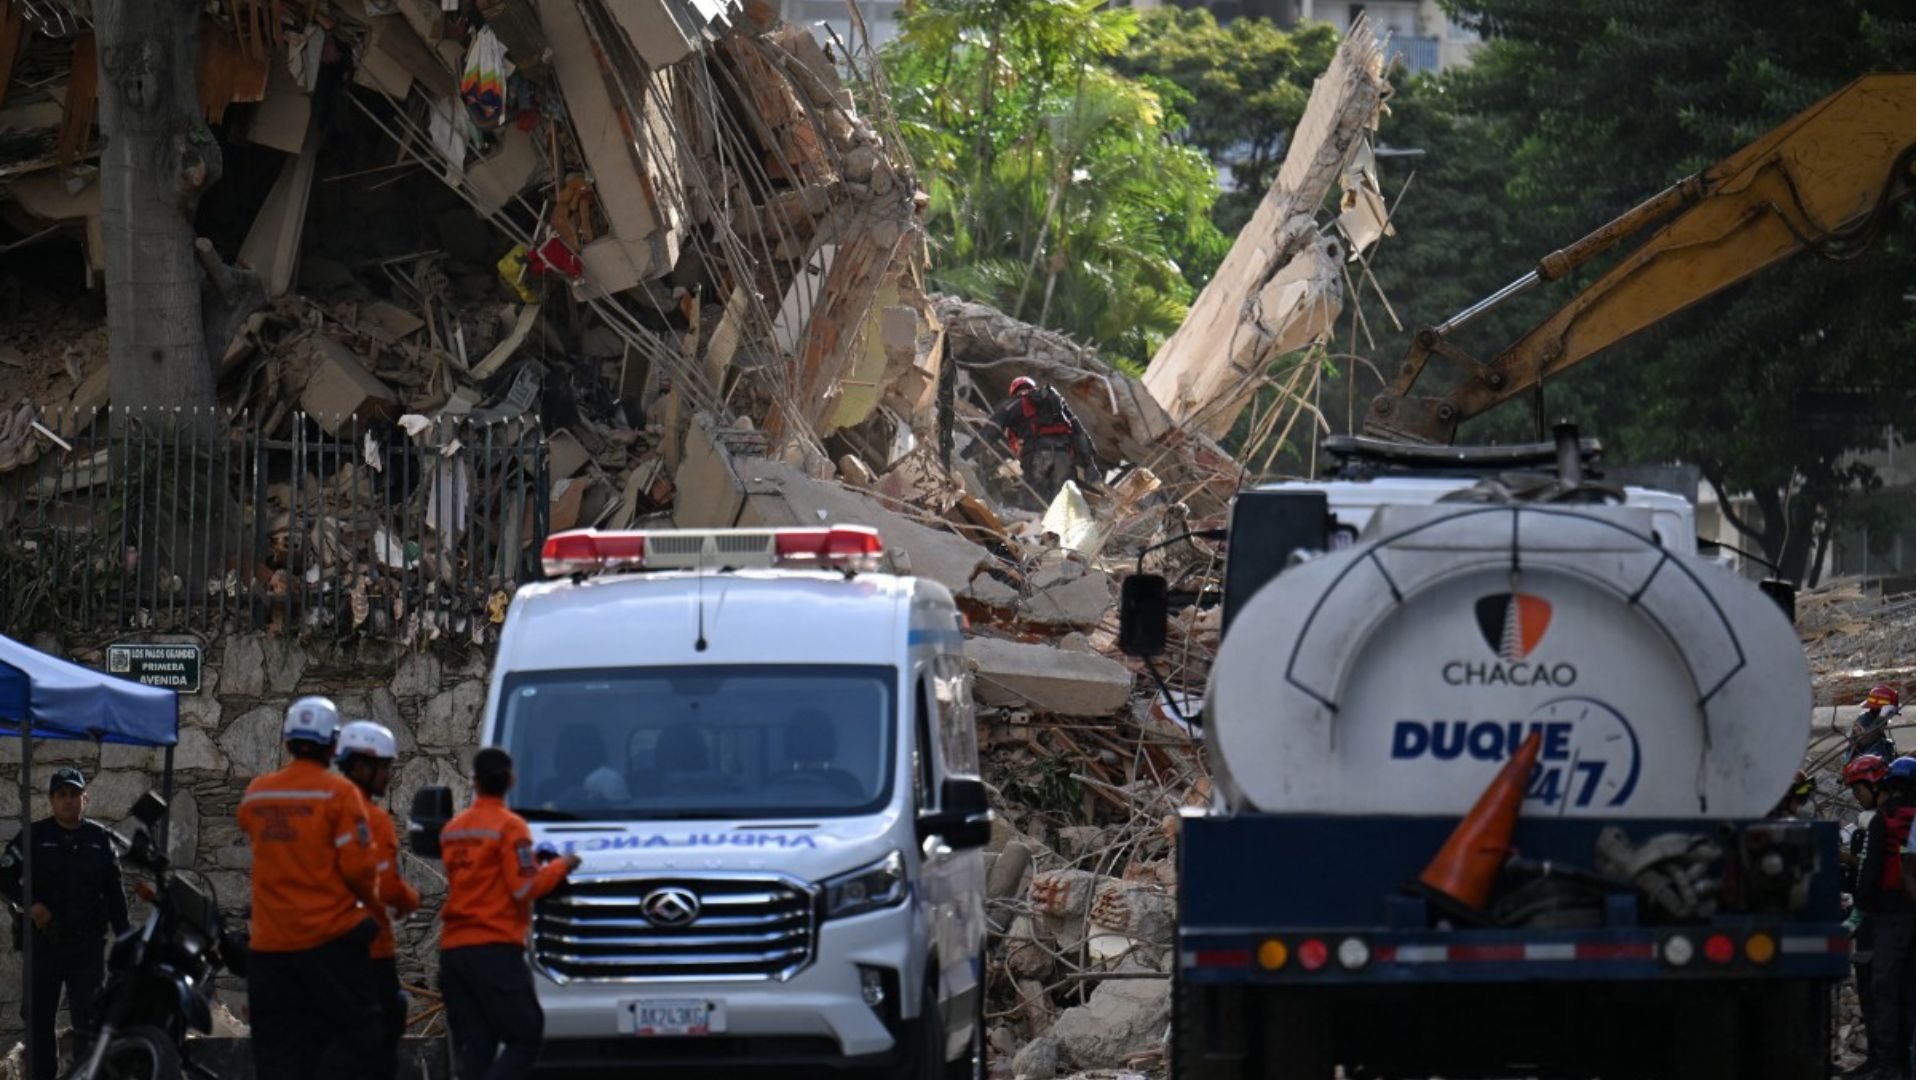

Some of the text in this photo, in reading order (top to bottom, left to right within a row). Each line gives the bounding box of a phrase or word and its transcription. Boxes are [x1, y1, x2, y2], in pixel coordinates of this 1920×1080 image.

[131, 648, 195, 660] LOS PALOS GRANDES
[142, 662, 185, 671] PRIMERA
[1442, 660, 1577, 687] CHACAO
[140, 675, 188, 686] AVENIDA
[1390, 721, 1574, 762] DUQUE
